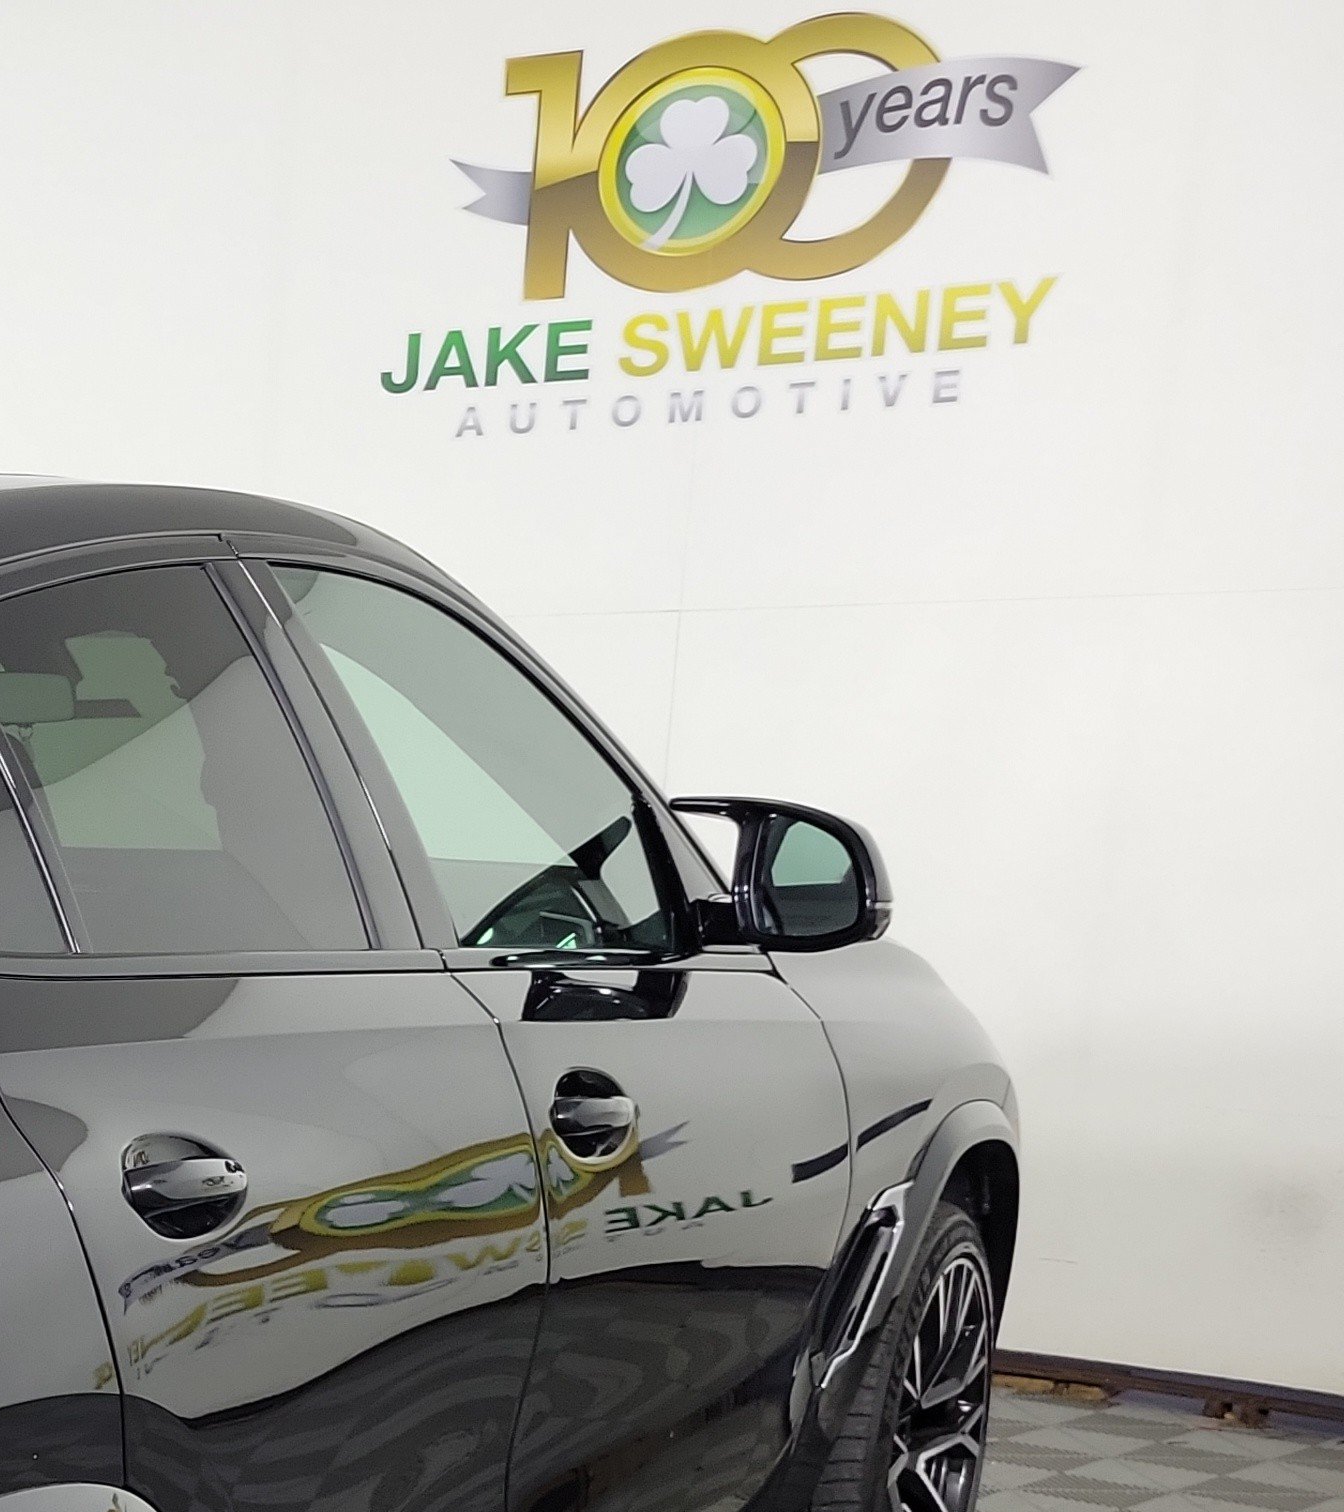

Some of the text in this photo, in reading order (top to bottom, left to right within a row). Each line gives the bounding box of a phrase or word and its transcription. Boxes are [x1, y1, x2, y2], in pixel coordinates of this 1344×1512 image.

[505, 11, 1018, 300] 100 years
[380, 276, 1059, 396] JAKE SWEENEY
[455, 369, 961, 438] AUTOMOTIVE
